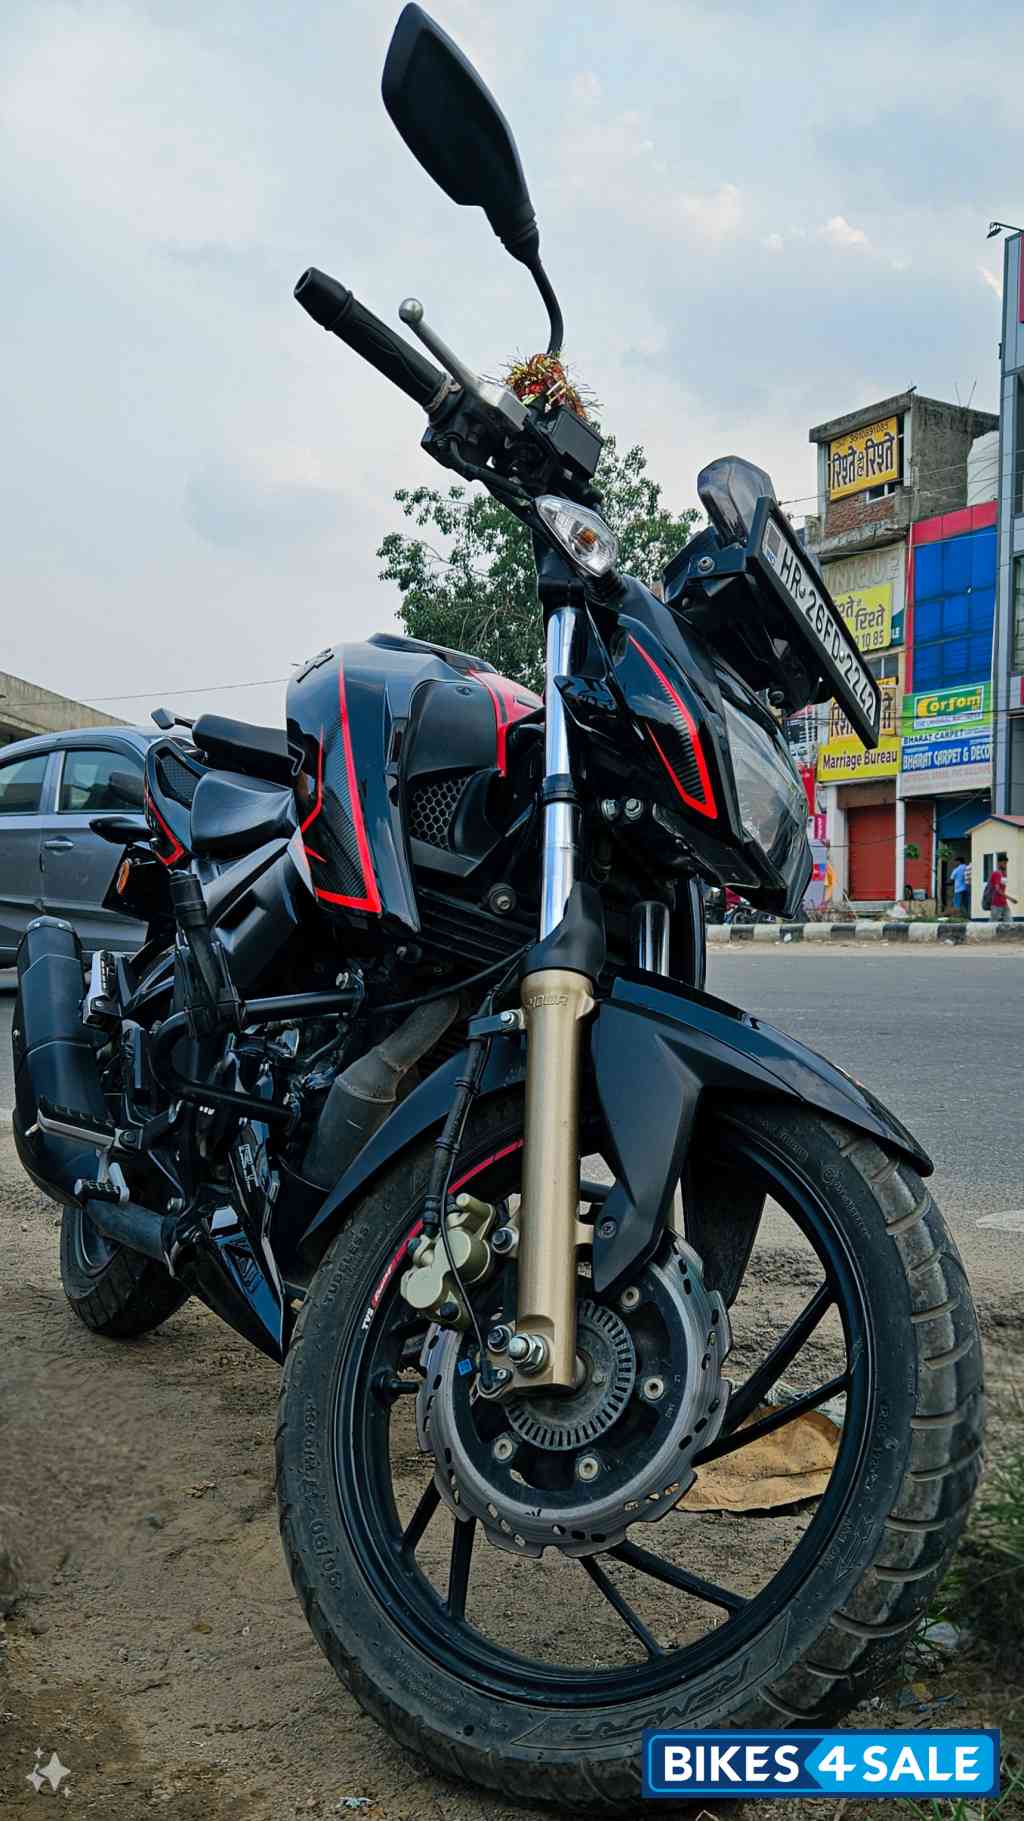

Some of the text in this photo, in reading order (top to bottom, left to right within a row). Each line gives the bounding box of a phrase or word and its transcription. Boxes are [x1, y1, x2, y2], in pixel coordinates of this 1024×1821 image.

[781, 546, 801, 601] HR
[823, 750, 898, 771] Marriage Bureau
